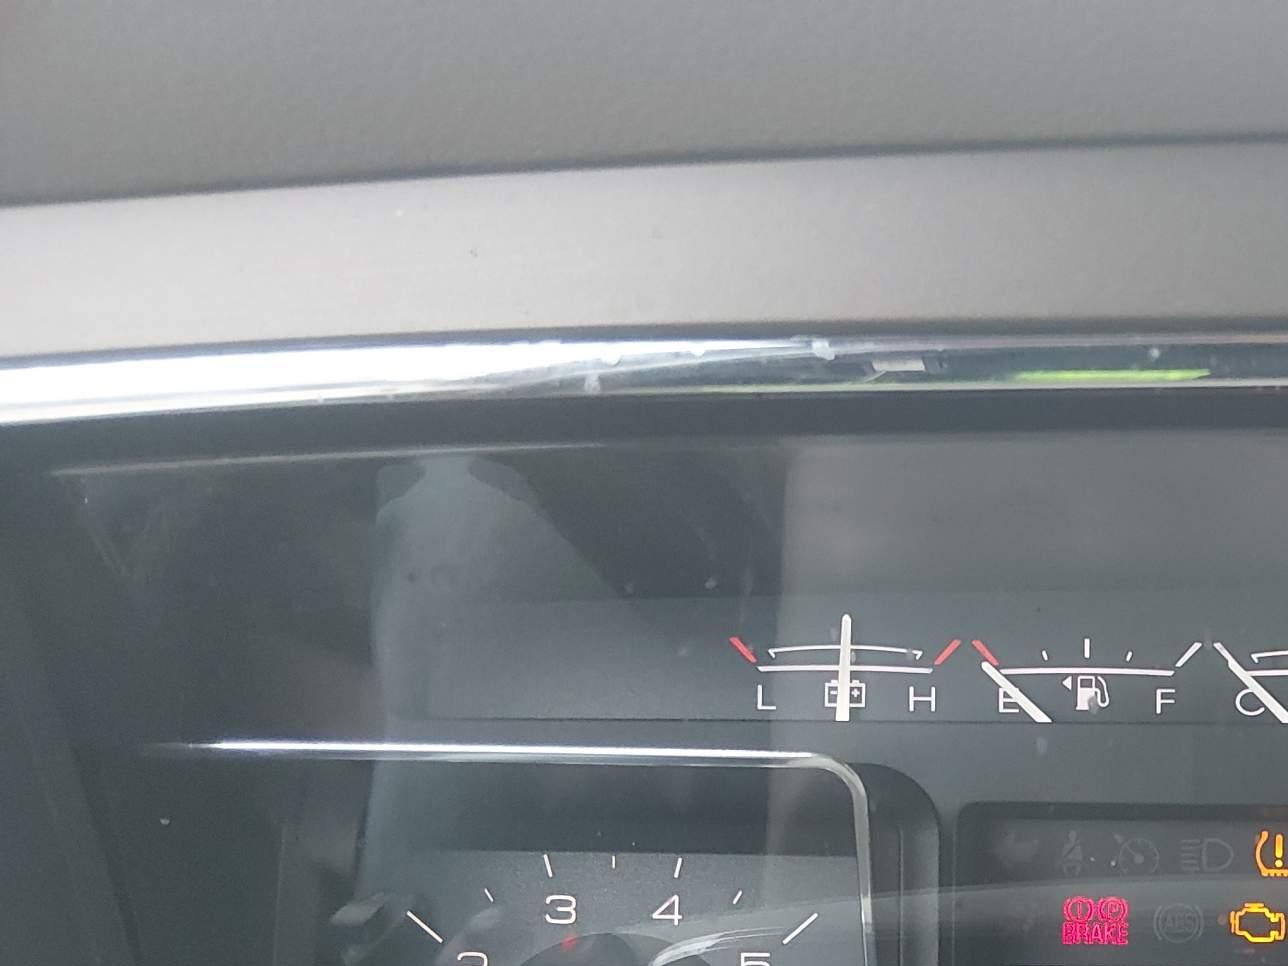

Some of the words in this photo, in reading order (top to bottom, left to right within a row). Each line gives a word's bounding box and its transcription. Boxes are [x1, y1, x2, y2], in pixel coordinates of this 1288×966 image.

[757, 685, 776, 709] L
[910, 686, 935, 711] H
[998, 687, 1020, 713] E
[1157, 689, 1175, 713] F
[1234, 688, 1265, 716] C
[545, 895, 576, 924] 3
[652, 895, 682, 925] 4
[1062, 922, 1129, 945] BRAKE
